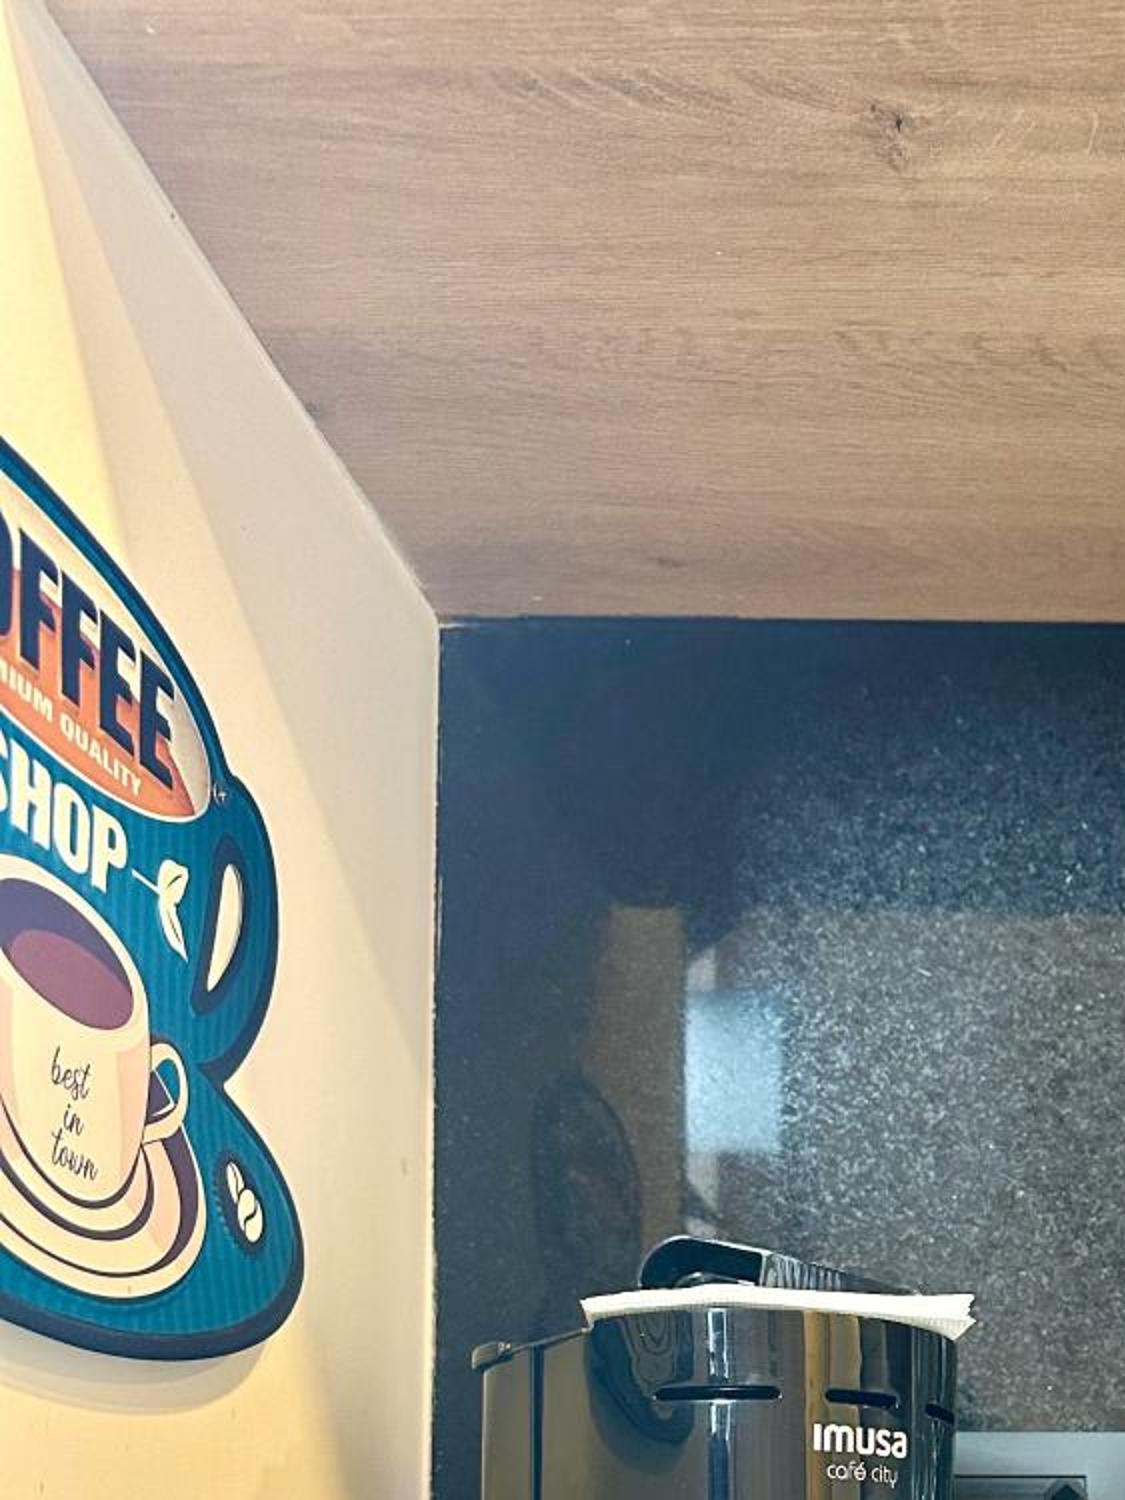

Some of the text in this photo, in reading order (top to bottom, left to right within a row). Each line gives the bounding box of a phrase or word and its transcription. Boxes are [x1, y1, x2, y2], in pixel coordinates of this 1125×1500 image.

[59, 713, 142, 796] QUALITY
[0, 727, 129, 893] HOP
[51, 1046, 91, 1101] best
[63, 1103, 84, 1136] in
[51, 1127, 98, 1181] town
[827, 1460, 899, 1489] café city
